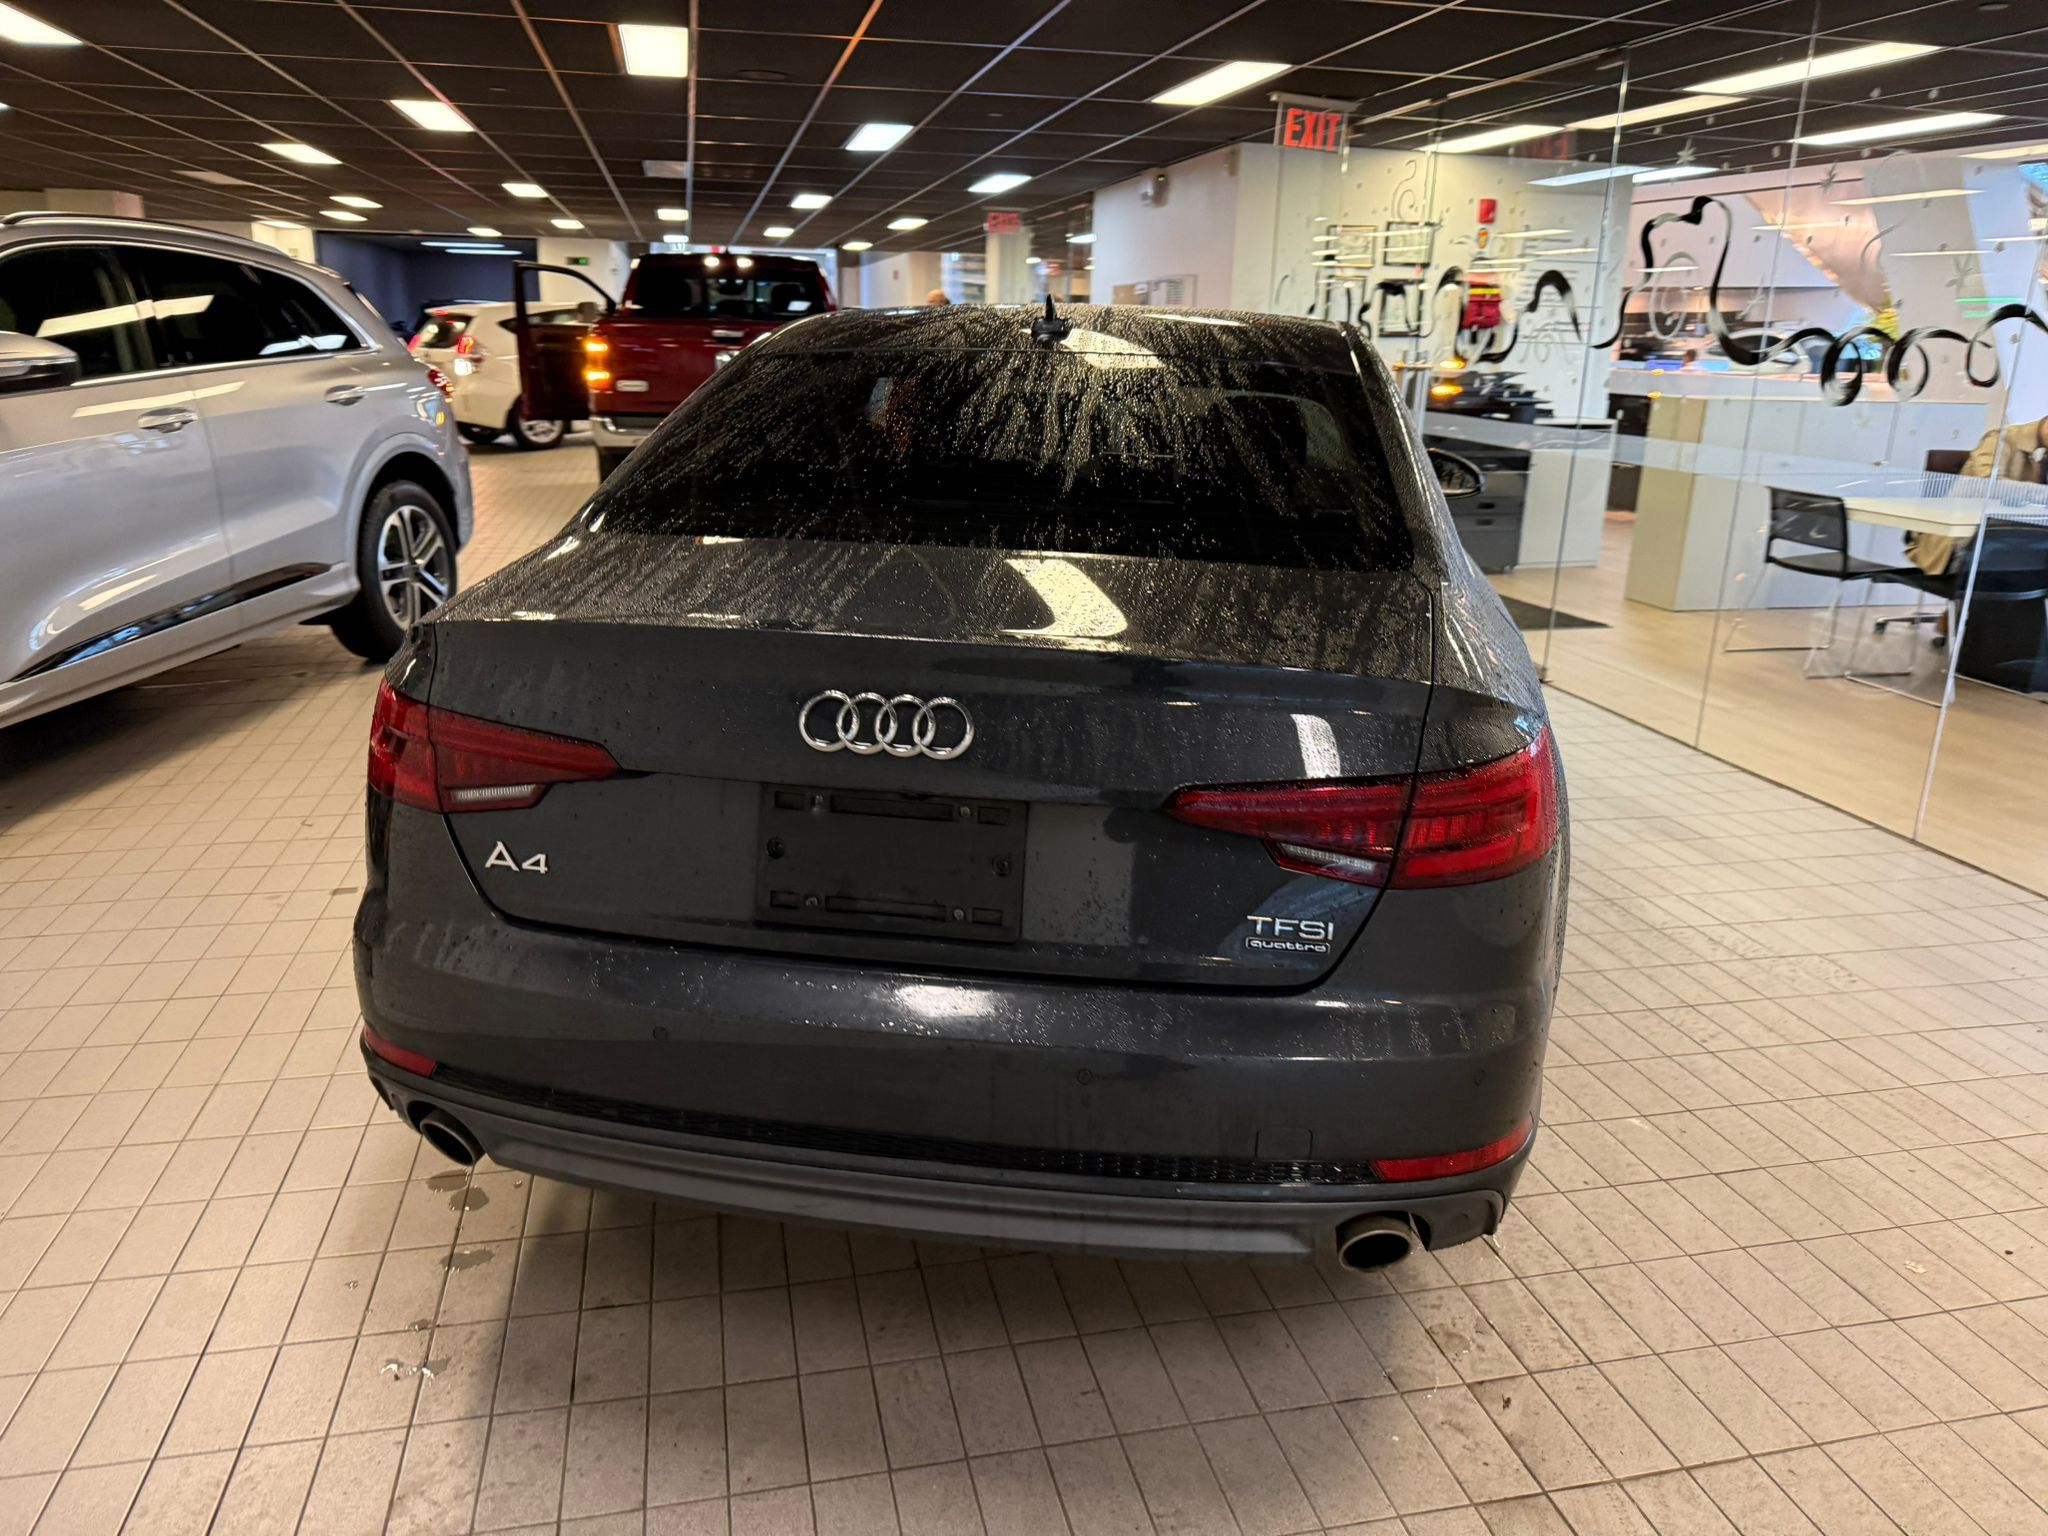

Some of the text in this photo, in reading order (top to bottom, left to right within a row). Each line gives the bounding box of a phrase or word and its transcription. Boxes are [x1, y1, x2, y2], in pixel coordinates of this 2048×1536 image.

[1284, 108, 1342, 152] EXIT
[485, 841, 548, 874] A4
[1246, 915, 1334, 940] TFSI
[1250, 940, 1326, 952] quattro
